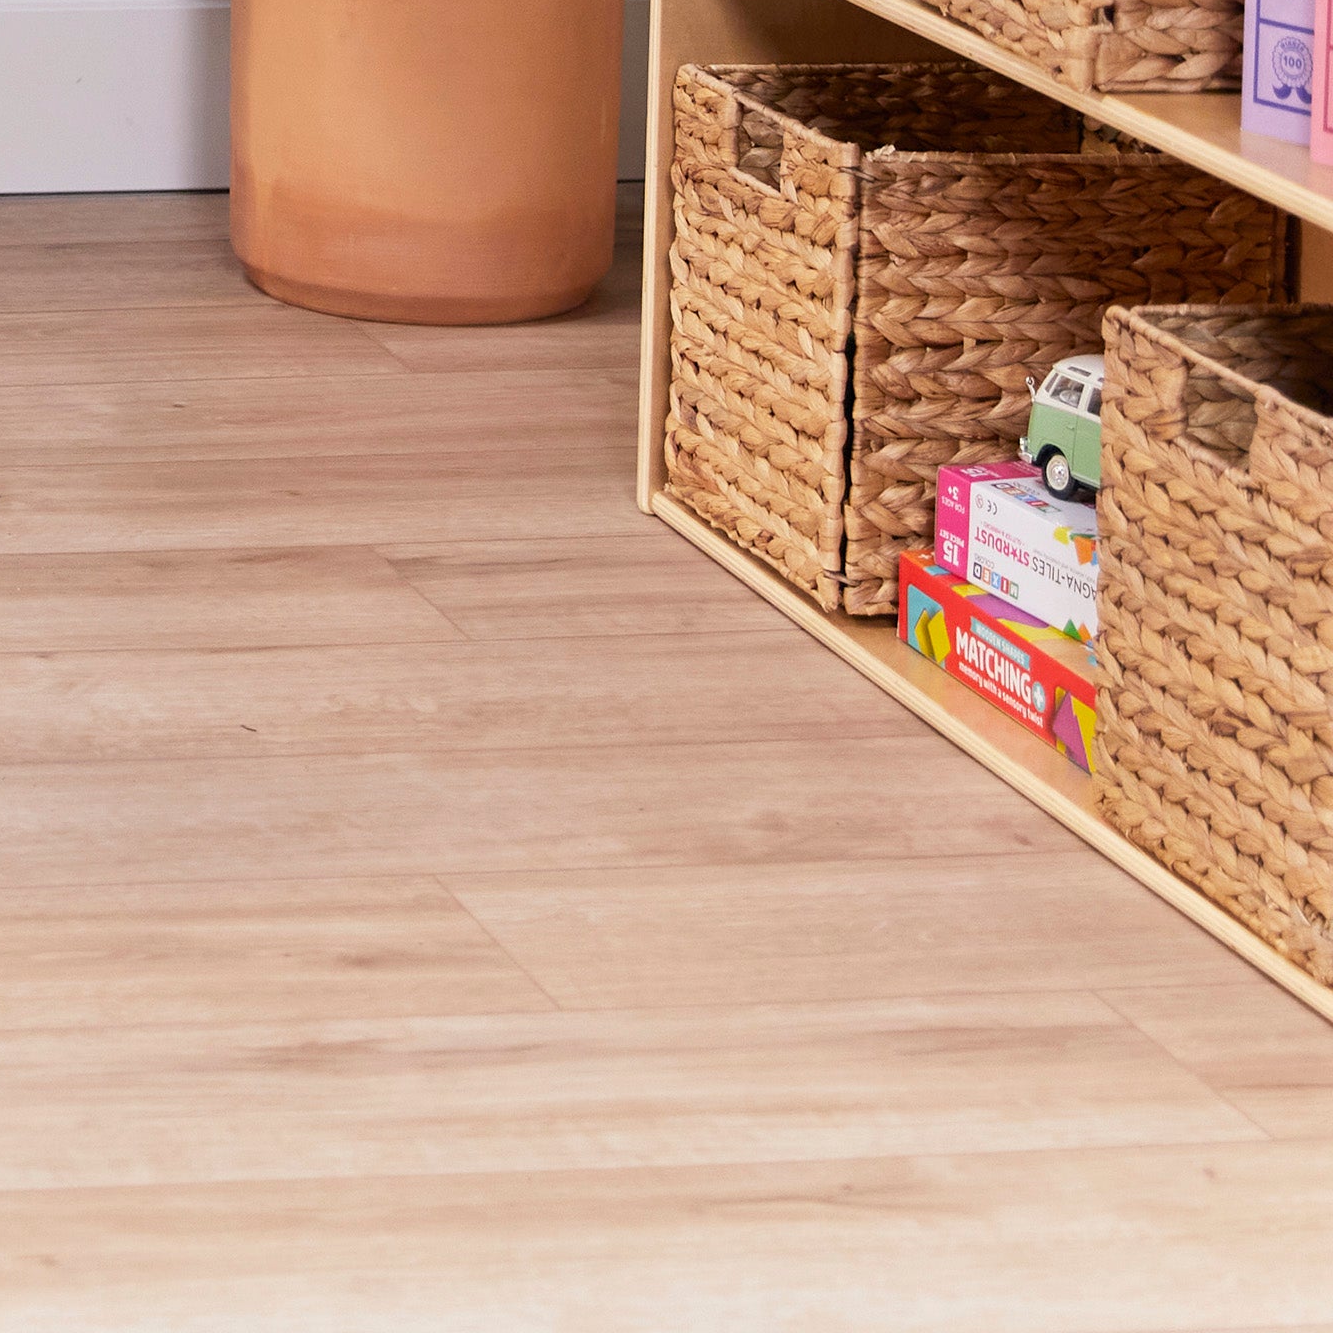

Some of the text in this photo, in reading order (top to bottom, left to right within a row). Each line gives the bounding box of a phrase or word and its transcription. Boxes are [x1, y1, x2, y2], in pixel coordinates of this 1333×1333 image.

[1284, 55, 1302, 69] 100
[948, 485, 959, 502] 3+
[954, 503, 965, 514] FOR
[940, 528, 965, 548] PIECE SET
[942, 540, 959, 567] 15
[973, 562, 1019, 600] MIXED
[956, 626, 1032, 705] MATCHING
[958, 661, 1043, 728] memory with a sensory twist
